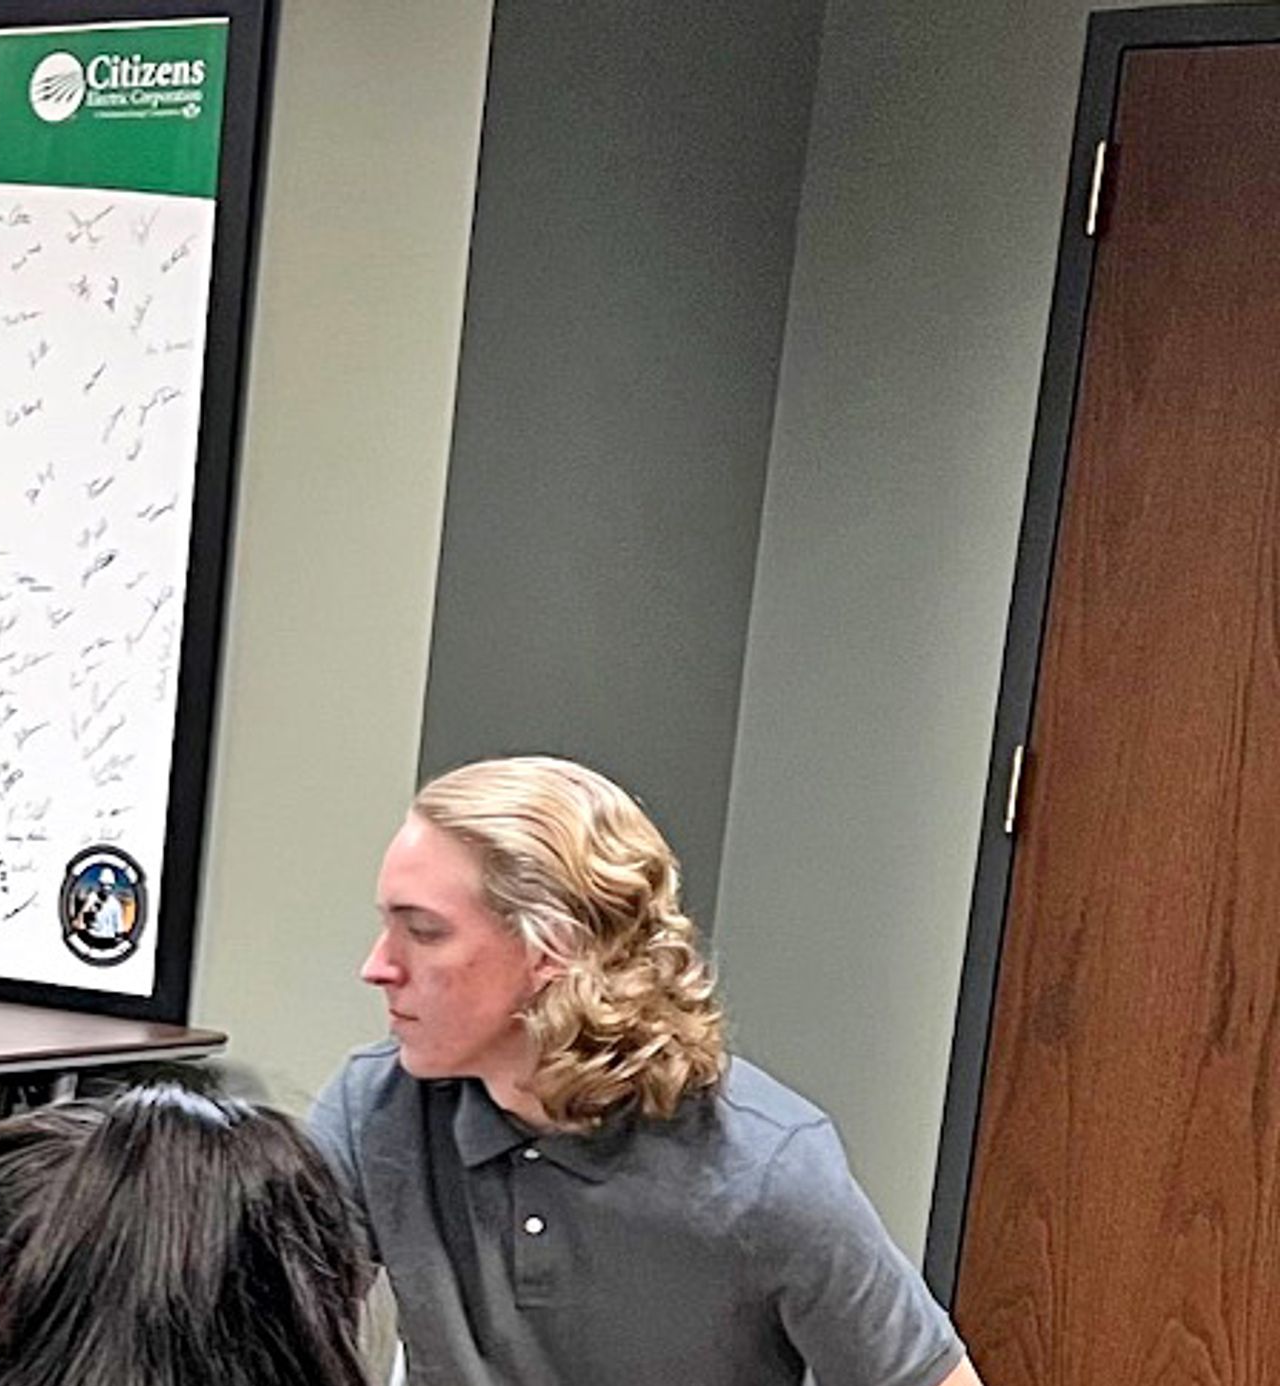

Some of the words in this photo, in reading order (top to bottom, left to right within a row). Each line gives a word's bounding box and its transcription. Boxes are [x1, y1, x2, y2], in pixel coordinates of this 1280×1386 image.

[86, 54, 206, 89] Citizens
[86, 92, 128, 106] Electric
[130, 90, 203, 108] Corporation
